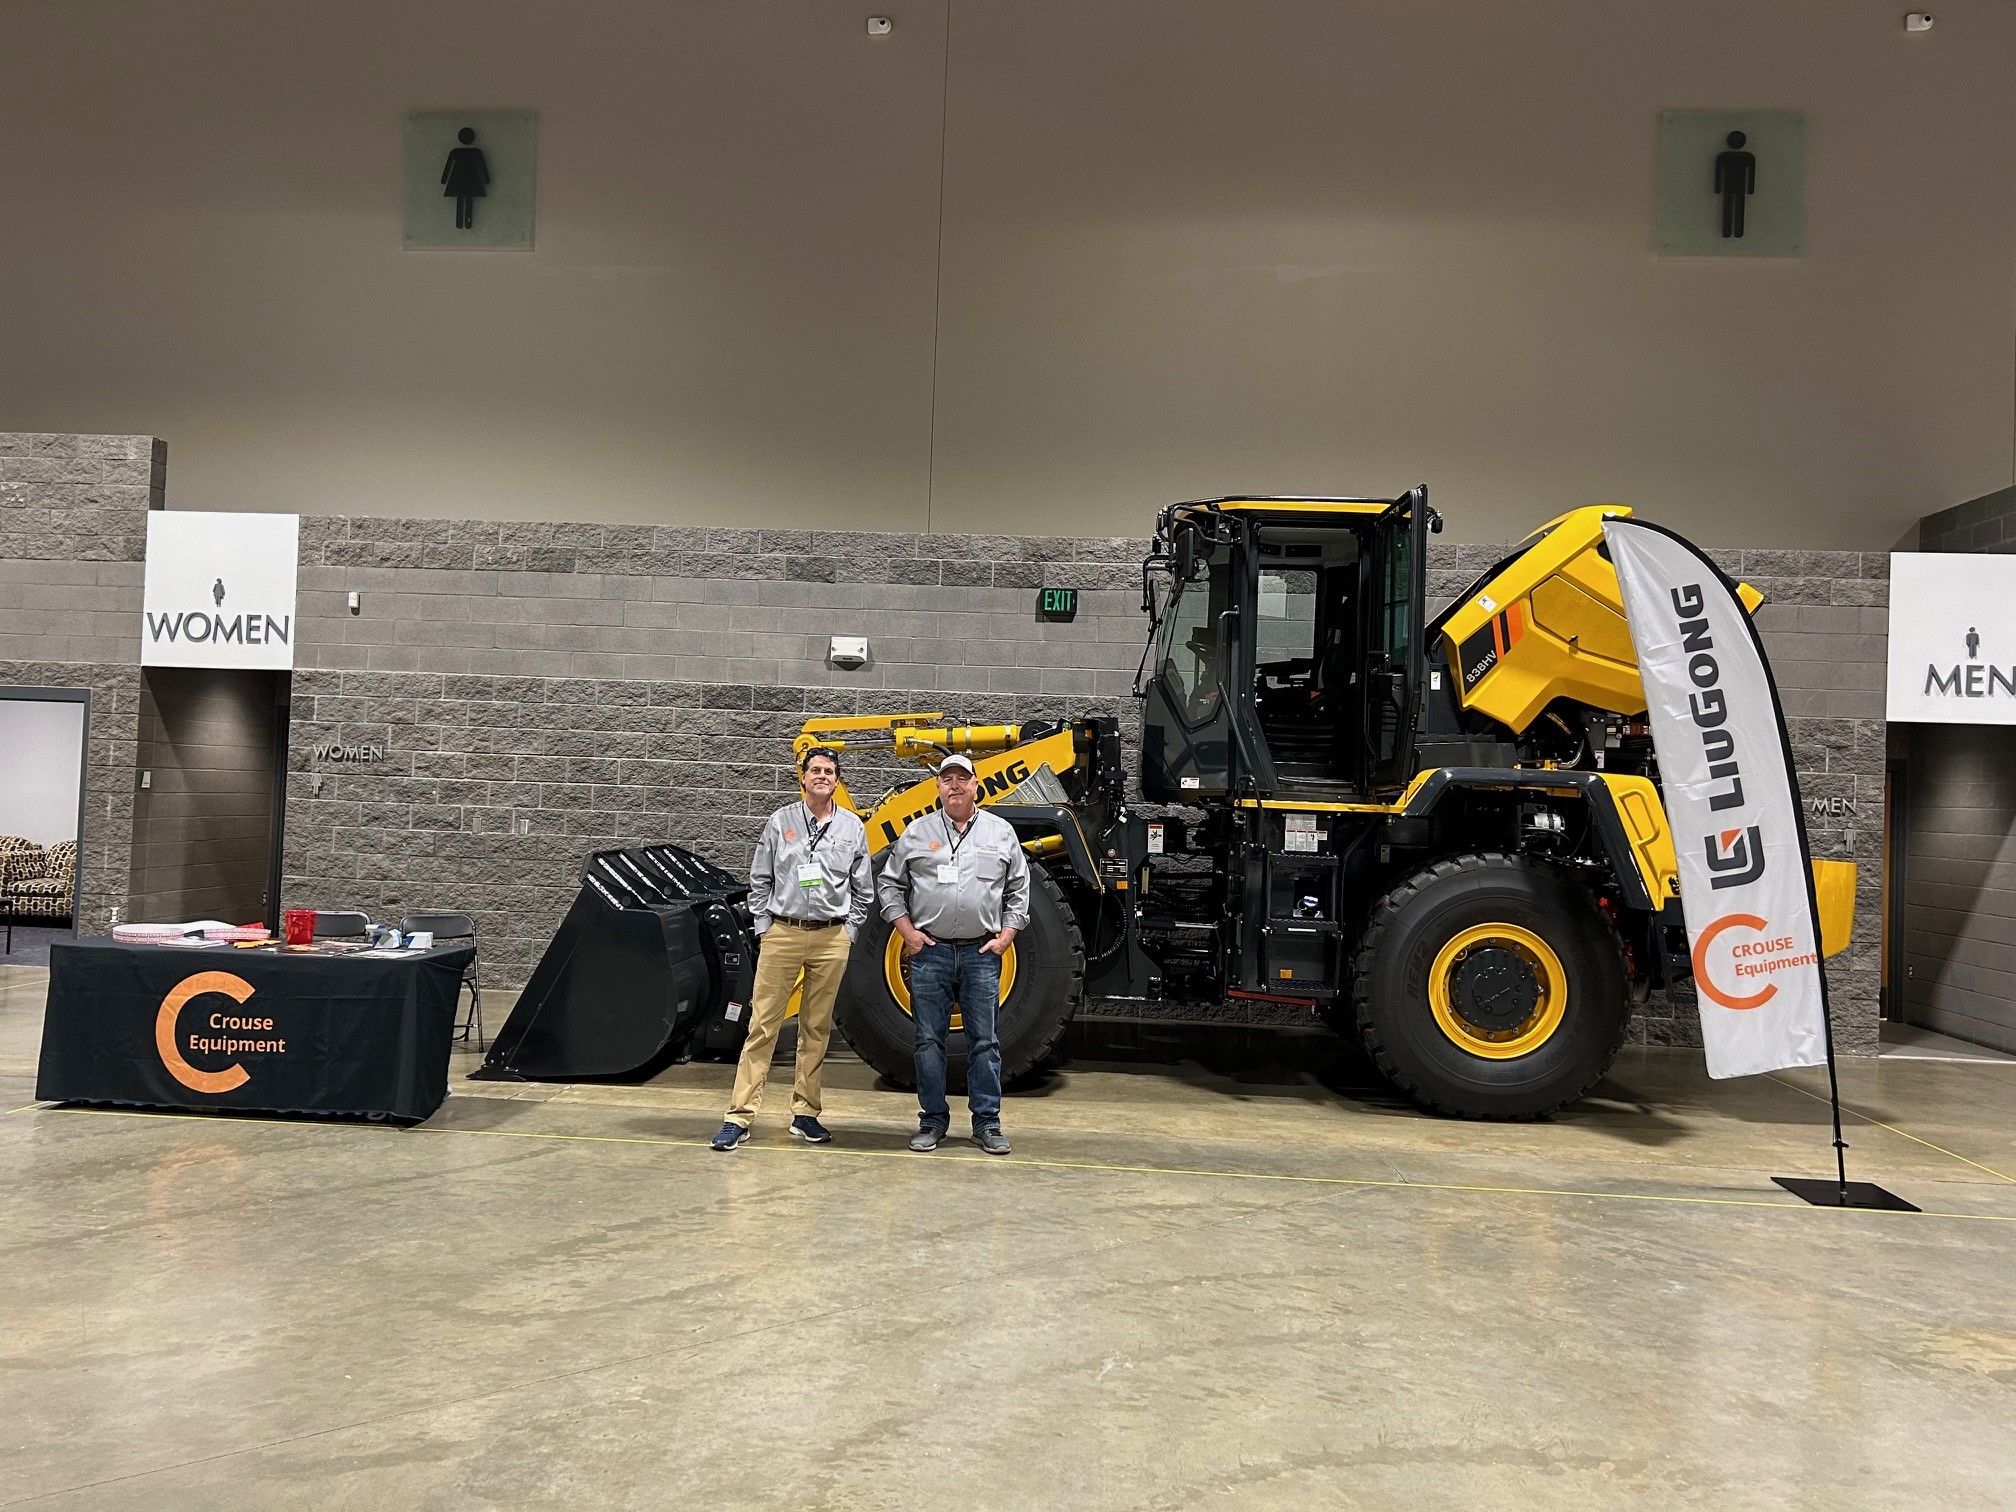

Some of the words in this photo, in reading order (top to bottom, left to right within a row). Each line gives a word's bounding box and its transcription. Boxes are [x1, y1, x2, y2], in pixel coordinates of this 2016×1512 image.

[1044, 589, 1073, 611] EXIT
[146, 611, 290, 645] WOMEN
[1466, 649, 1497, 683] 838HV
[1924, 663, 2016, 698] MEN
[1670, 583, 1745, 812] LIUGONG
[312, 744, 384, 762] WOMEN
[1811, 797, 1857, 815] MEN
[1732, 937, 1794, 958] CROUSE
[1734, 952, 1818, 977] Equipment
[209, 1013, 274, 1030] Crouse
[189, 1034, 286, 1056] Equipment
